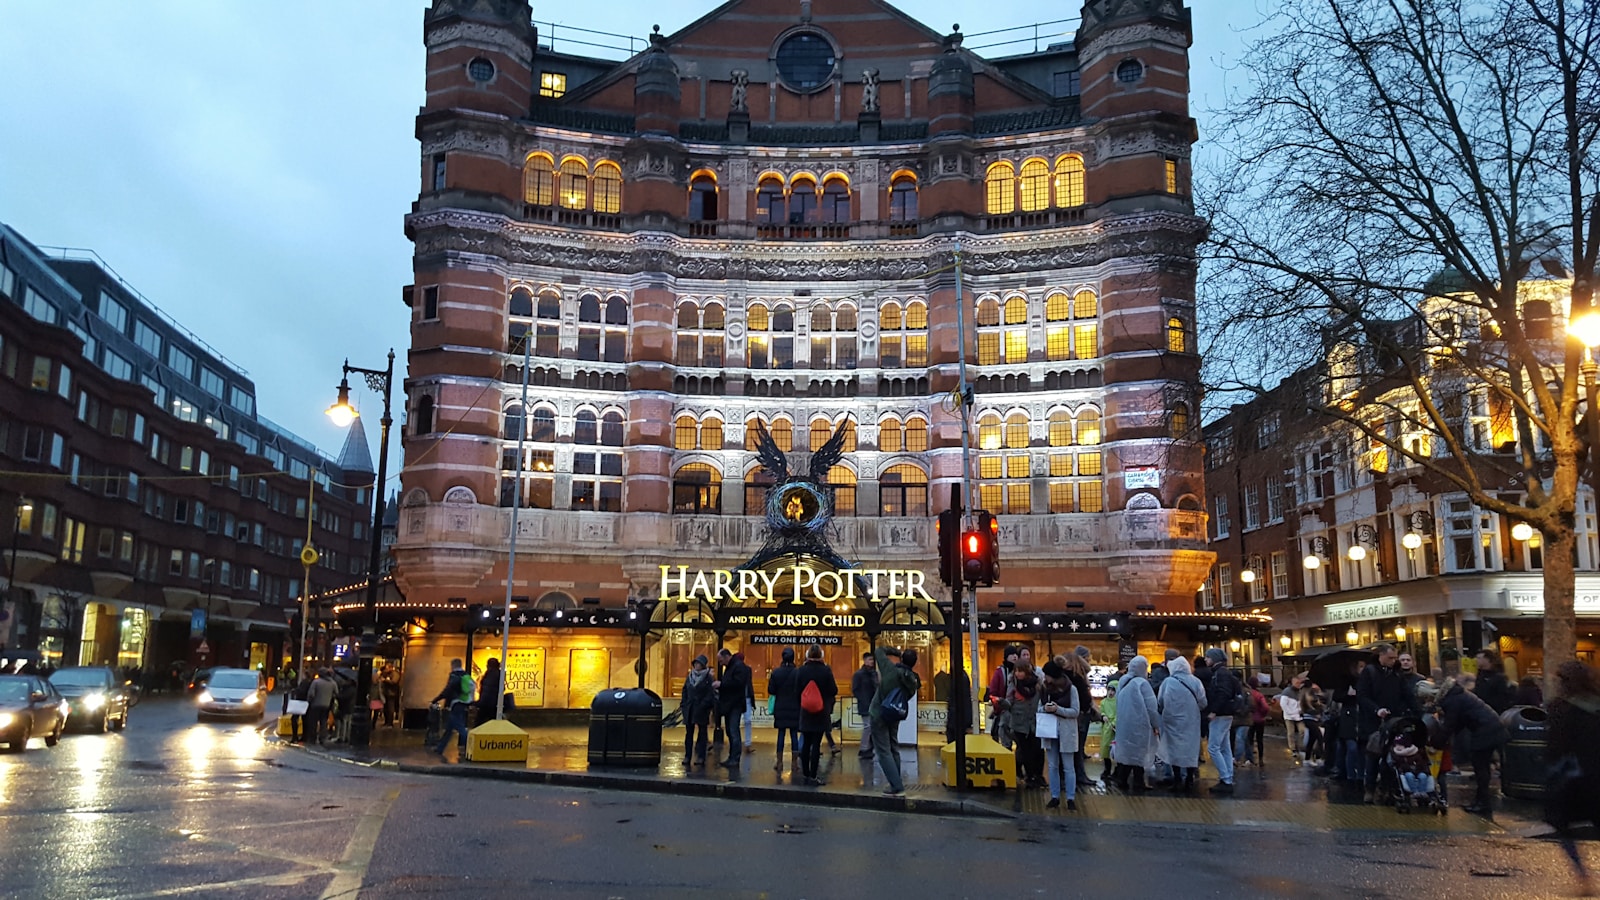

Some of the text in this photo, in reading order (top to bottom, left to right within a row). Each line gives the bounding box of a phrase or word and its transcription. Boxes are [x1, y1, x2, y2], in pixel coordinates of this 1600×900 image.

[658, 565, 937, 605] HARRY POTTER
[1513, 595, 1538, 604] THE
[1328, 603, 1399, 622] THE SPICE OF LIFE
[728, 614, 866, 627] AND THE CURSED CHILD
[505, 670, 540, 681] HARRY
[504, 680, 541, 690] POTTER
[479, 739, 523, 750] Urban64
[965, 756, 1003, 775] SRL
